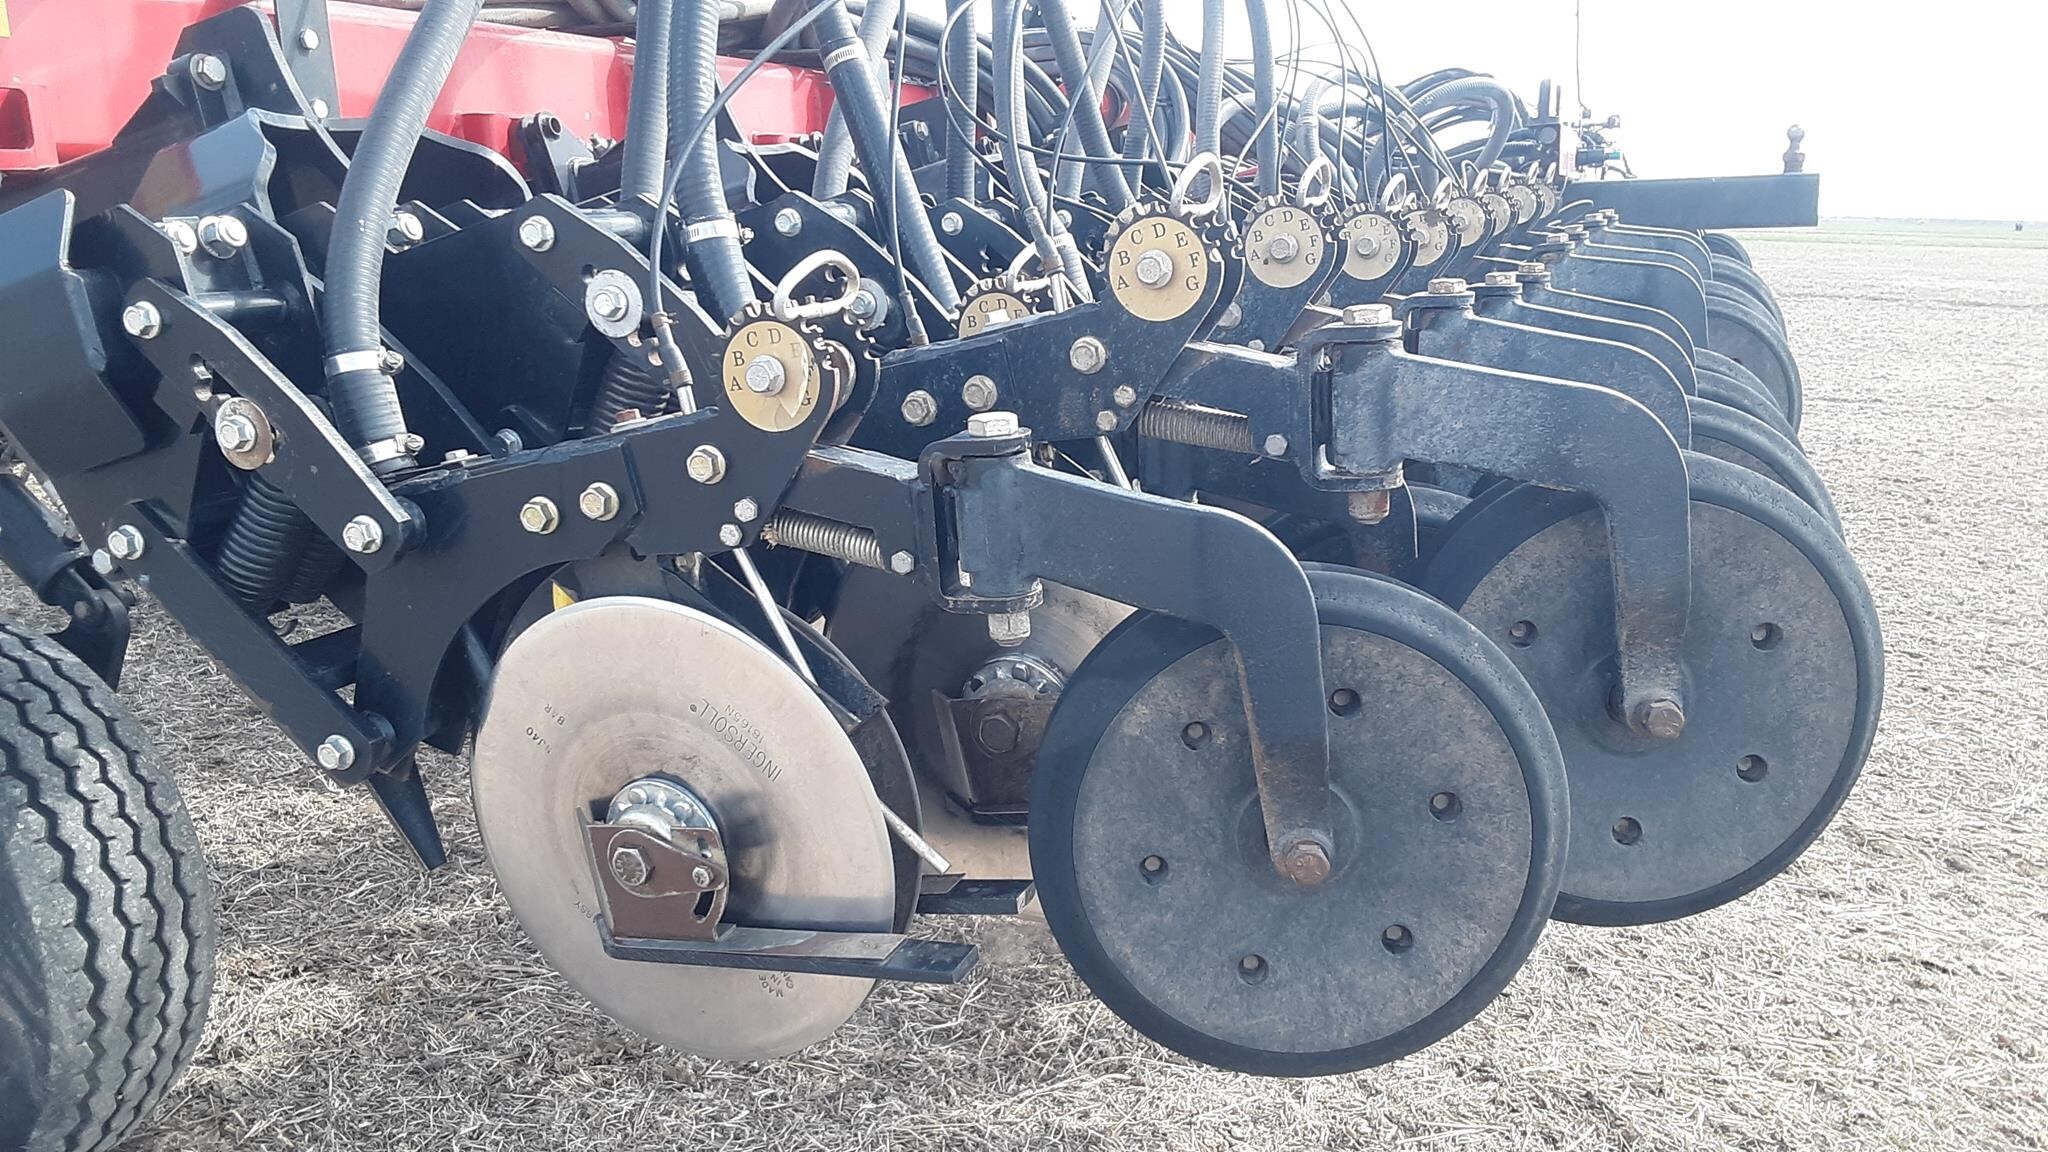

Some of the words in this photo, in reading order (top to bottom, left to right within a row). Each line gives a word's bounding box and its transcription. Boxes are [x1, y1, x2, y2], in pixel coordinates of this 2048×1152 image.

[1265, 215, 1274, 227] C
[1282, 210, 1293, 222] D
[1152, 223, 1166, 238] D
[1299, 219, 1310, 231] E
[1354, 220, 1362, 229] C
[1131, 229, 1143, 245] C
[1174, 231, 1188, 248] E
[1253, 231, 1263, 243] B
[1310, 235, 1318, 247] F
[1117, 250, 1131, 266] B
[1189, 252, 1200, 268] F
[1251, 249, 1260, 261] A
[1305, 253, 1316, 265] G
[1117, 275, 1129, 290] A
[1186, 275, 1199, 291] G
[967, 315, 977, 328] B
[979, 300, 988, 313] C
[746, 331, 759, 348] C
[768, 328, 781, 344] D
[732, 350, 745, 367] B
[730, 376, 743, 391] A
